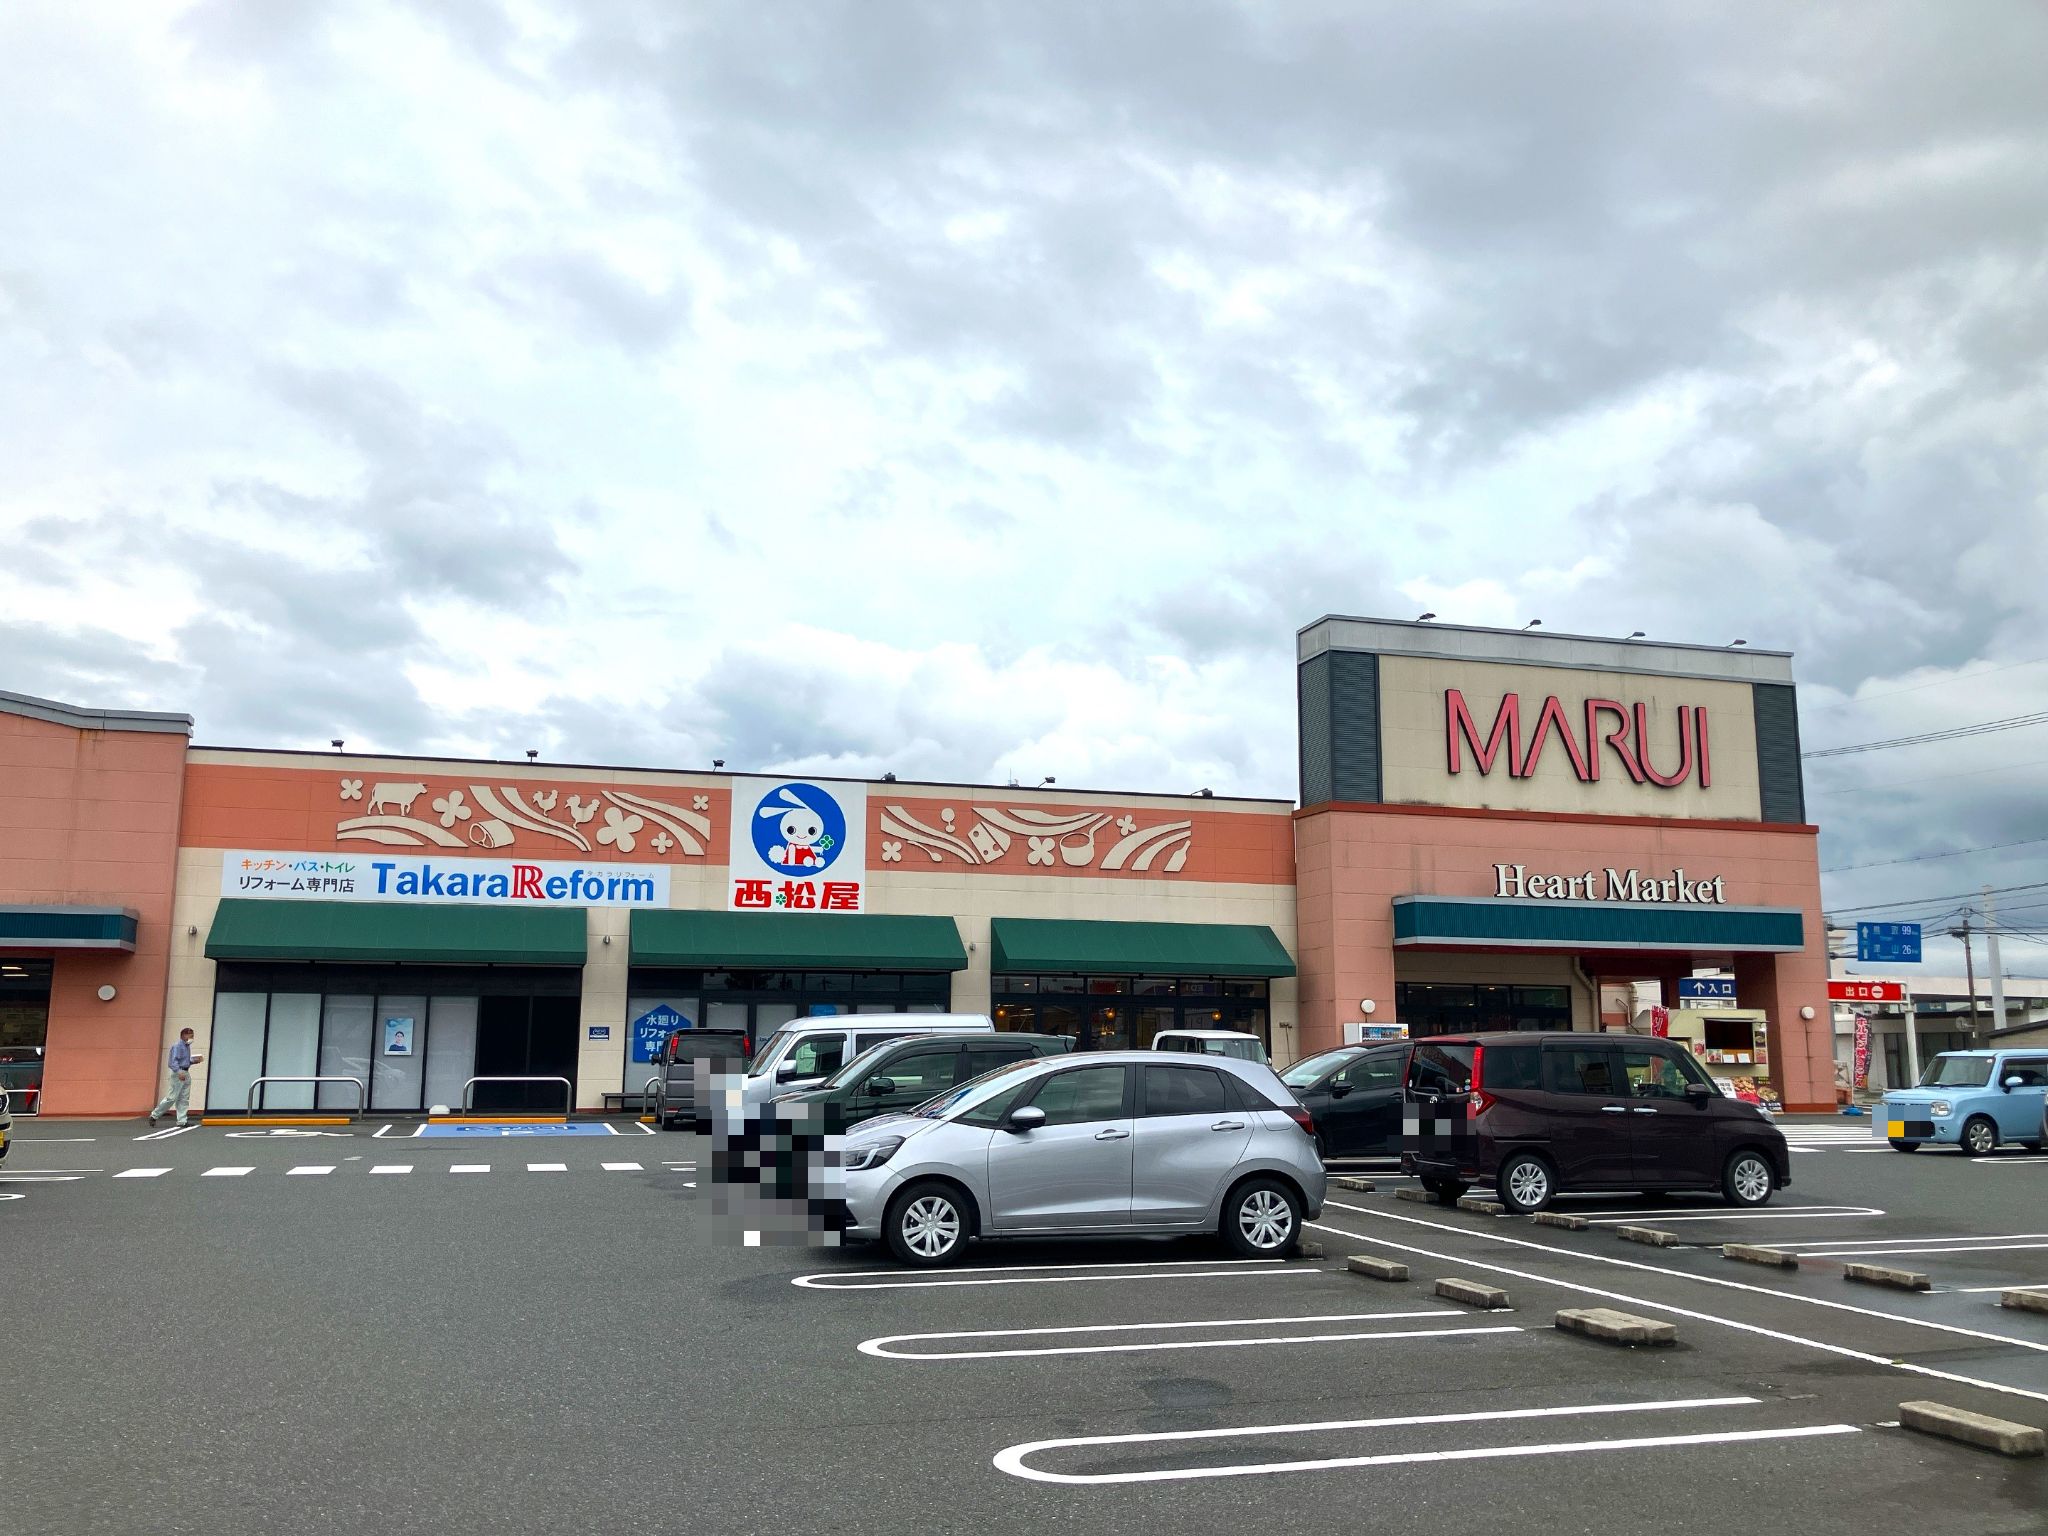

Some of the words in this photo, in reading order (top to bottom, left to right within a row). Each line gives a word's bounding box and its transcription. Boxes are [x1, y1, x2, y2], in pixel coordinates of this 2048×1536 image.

[1445, 689, 1711, 788] MARUI
[241, 859, 355, 873] キッチン・バス・トイレ
[240, 876, 355, 893] リフォーム専門店
[372, 862, 654, 901] TakaraReform
[1492, 864, 1598, 900] Heart
[1603, 868, 1727, 904] Market
[734, 879, 860, 910] 西松屋
[1901, 925, 1912, 936] 99
[1902, 944, 1911, 955] 26
[1708, 983, 1732, 994] 入口
[1845, 986, 1868, 997] 出口
[646, 1015, 679, 1026] 水廻り
[640, 1028, 671, 1039] リフォー
